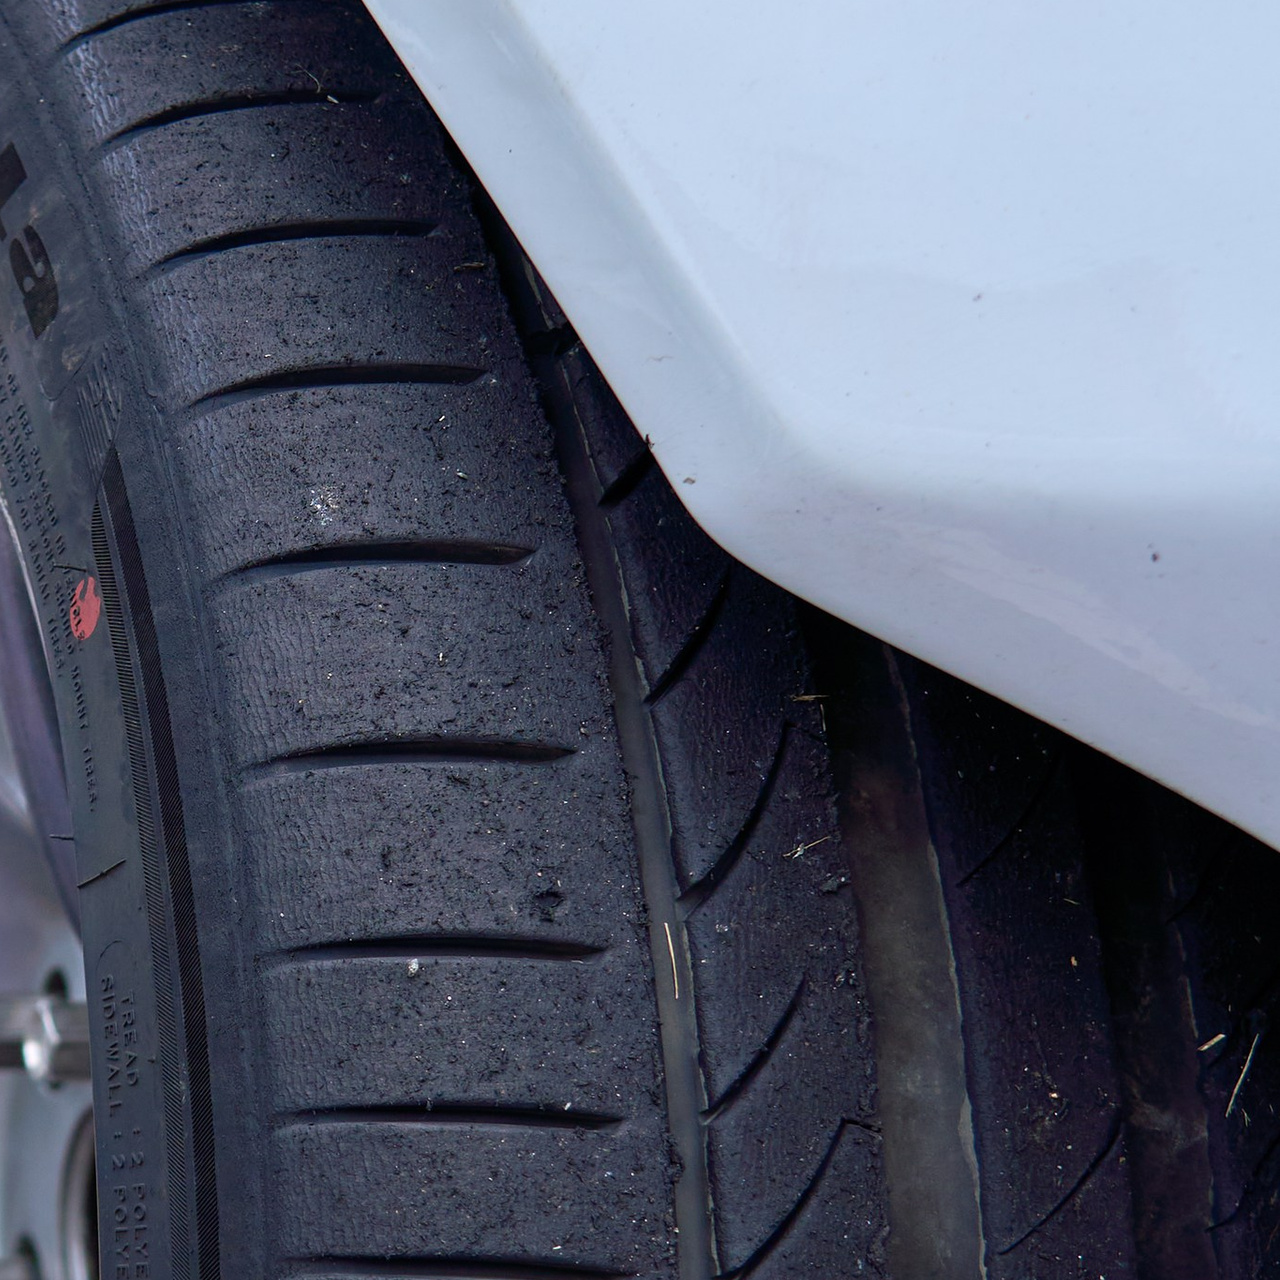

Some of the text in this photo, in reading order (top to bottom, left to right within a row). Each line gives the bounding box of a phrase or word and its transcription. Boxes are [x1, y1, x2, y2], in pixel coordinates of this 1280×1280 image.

[16, 398, 32, 442] TIRE
[29, 442, 58, 529] PLACARD
[28, 536, 51, 606] RADIAL
[47, 615, 67, 678] TIRES.
[53, 578, 76, 656] SHOULD
[69, 663, 89, 730] MOUNT
[83, 744, 96, 812] TIRES.
[100, 973, 123, 1118] SIDEWALL
[112, 1153, 126, 1170] 2
[121, 988, 139, 1087] TREAD
[130, 1151, 144, 1168] 2
